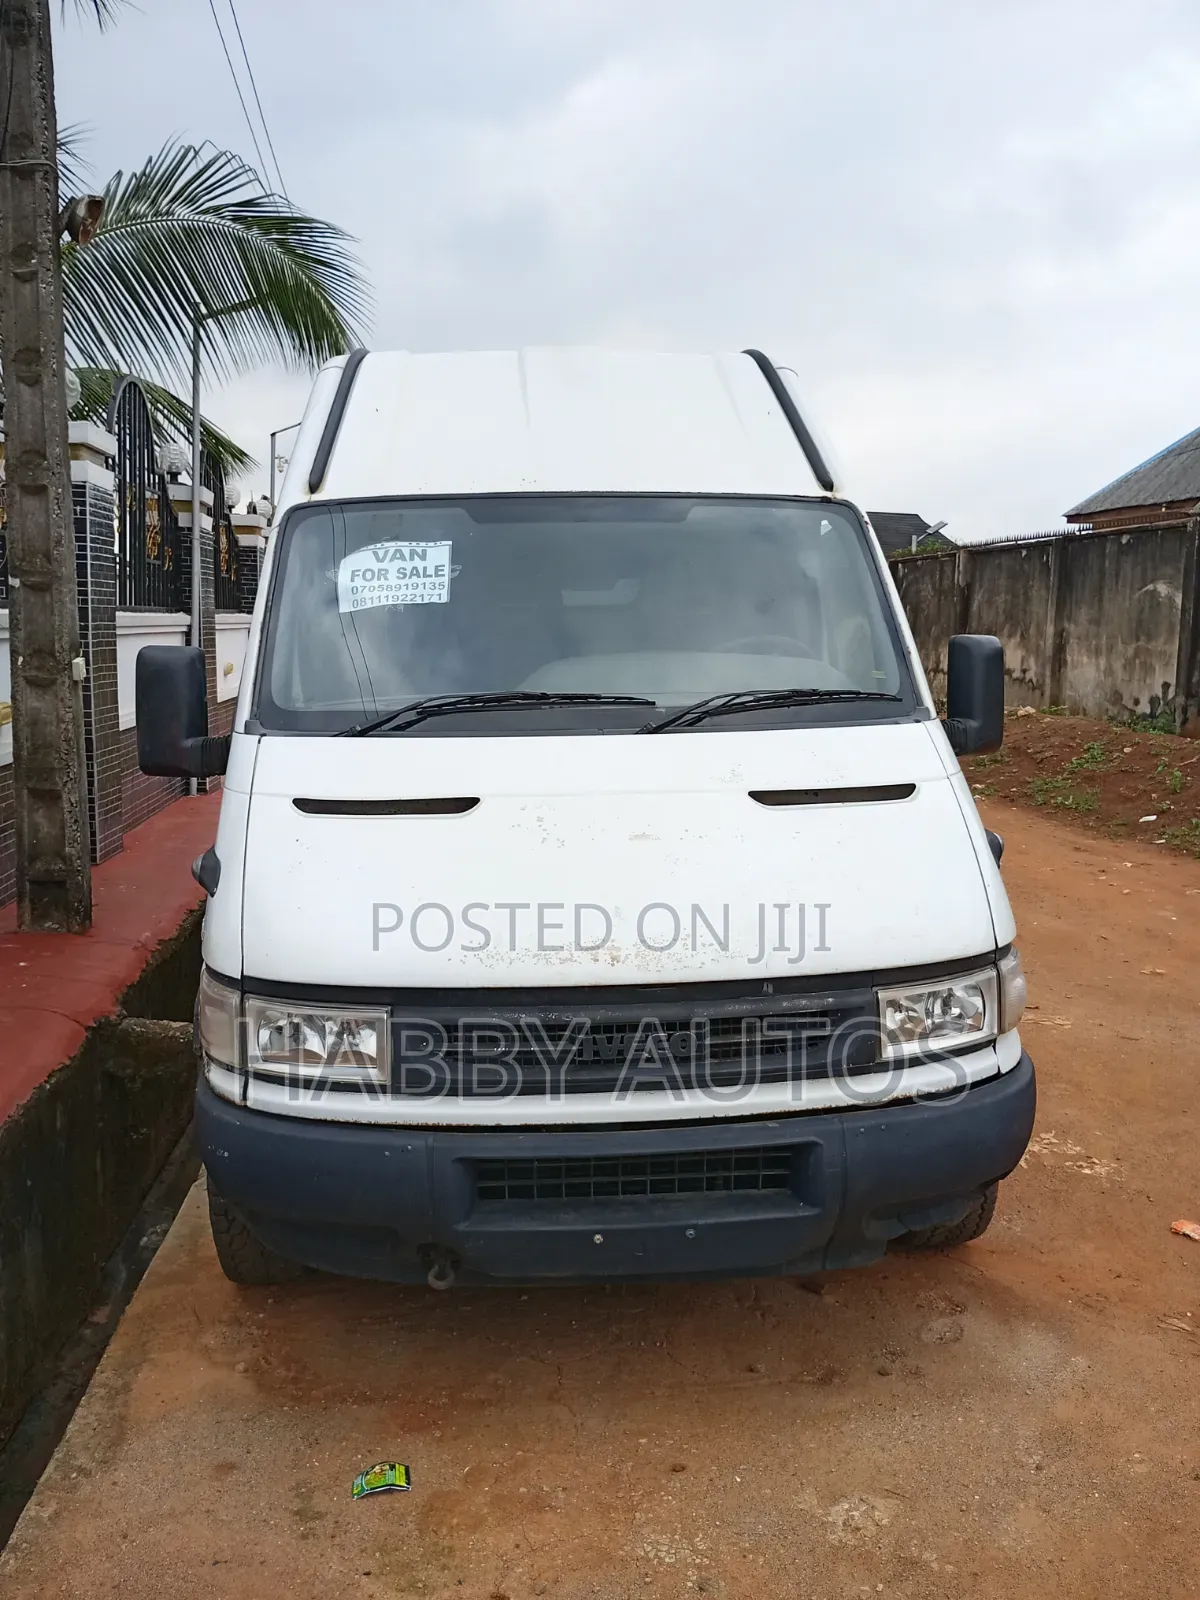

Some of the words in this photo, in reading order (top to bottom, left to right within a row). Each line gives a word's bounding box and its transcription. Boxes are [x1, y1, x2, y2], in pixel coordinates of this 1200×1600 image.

[371, 548, 428, 563] VAN
[350, 568, 390, 582] FOR
[395, 564, 446, 580] SALE
[351, 581, 446, 595] 07058919135
[352, 593, 442, 609] 08111922171
